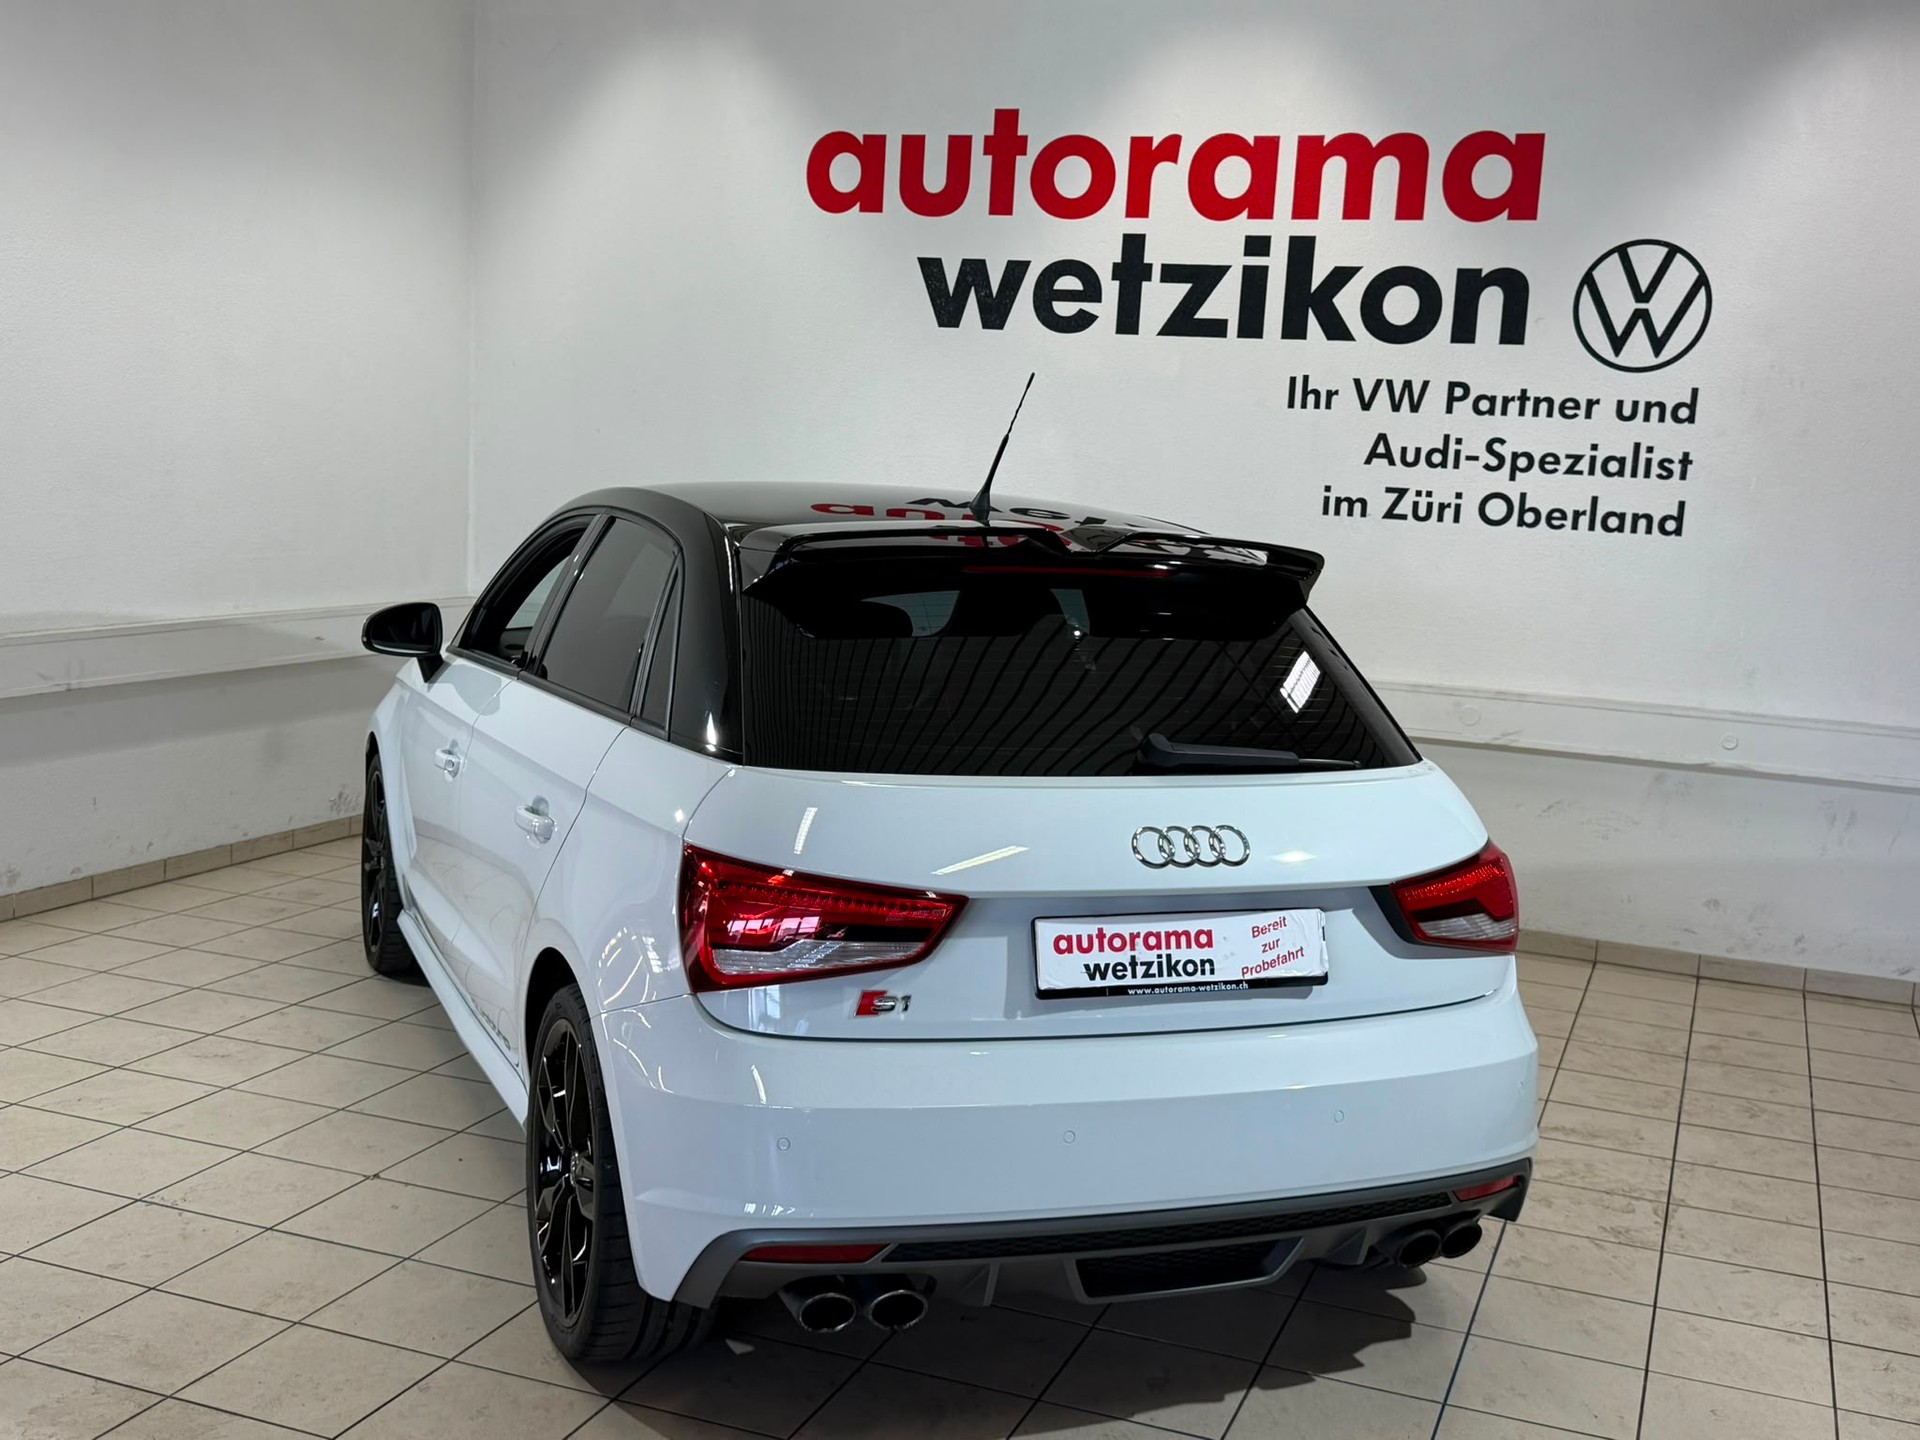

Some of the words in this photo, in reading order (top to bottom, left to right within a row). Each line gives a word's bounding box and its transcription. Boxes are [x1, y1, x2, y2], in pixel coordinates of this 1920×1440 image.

[806, 108, 1546, 223] autorama
[916, 233, 1530, 346] wetzikon
[1574, 240, 1711, 372] VW
[1286, 374, 1339, 410] Ihr
[1352, 377, 1431, 414] VW
[1445, 380, 1601, 420] Partner
[1615, 387, 1699, 425] und
[1363, 432, 1694, 482] Audi-Spezialist
[1322, 485, 1368, 518] im
[1381, 486, 1463, 524] Züri
[1478, 491, 1686, 537] Oberland
[1053, 927, 1214, 955] autorama
[1251, 915, 1288, 939] Bereit
[1241, 945, 1305, 978] Probefahrt
[1261, 938, 1281, 953] zur
[1082, 953, 1216, 981] wetzikon
[868, 992, 912, 1013] S1
[1127, 981, 1249, 995] www.autorama-wetzikon.ch
